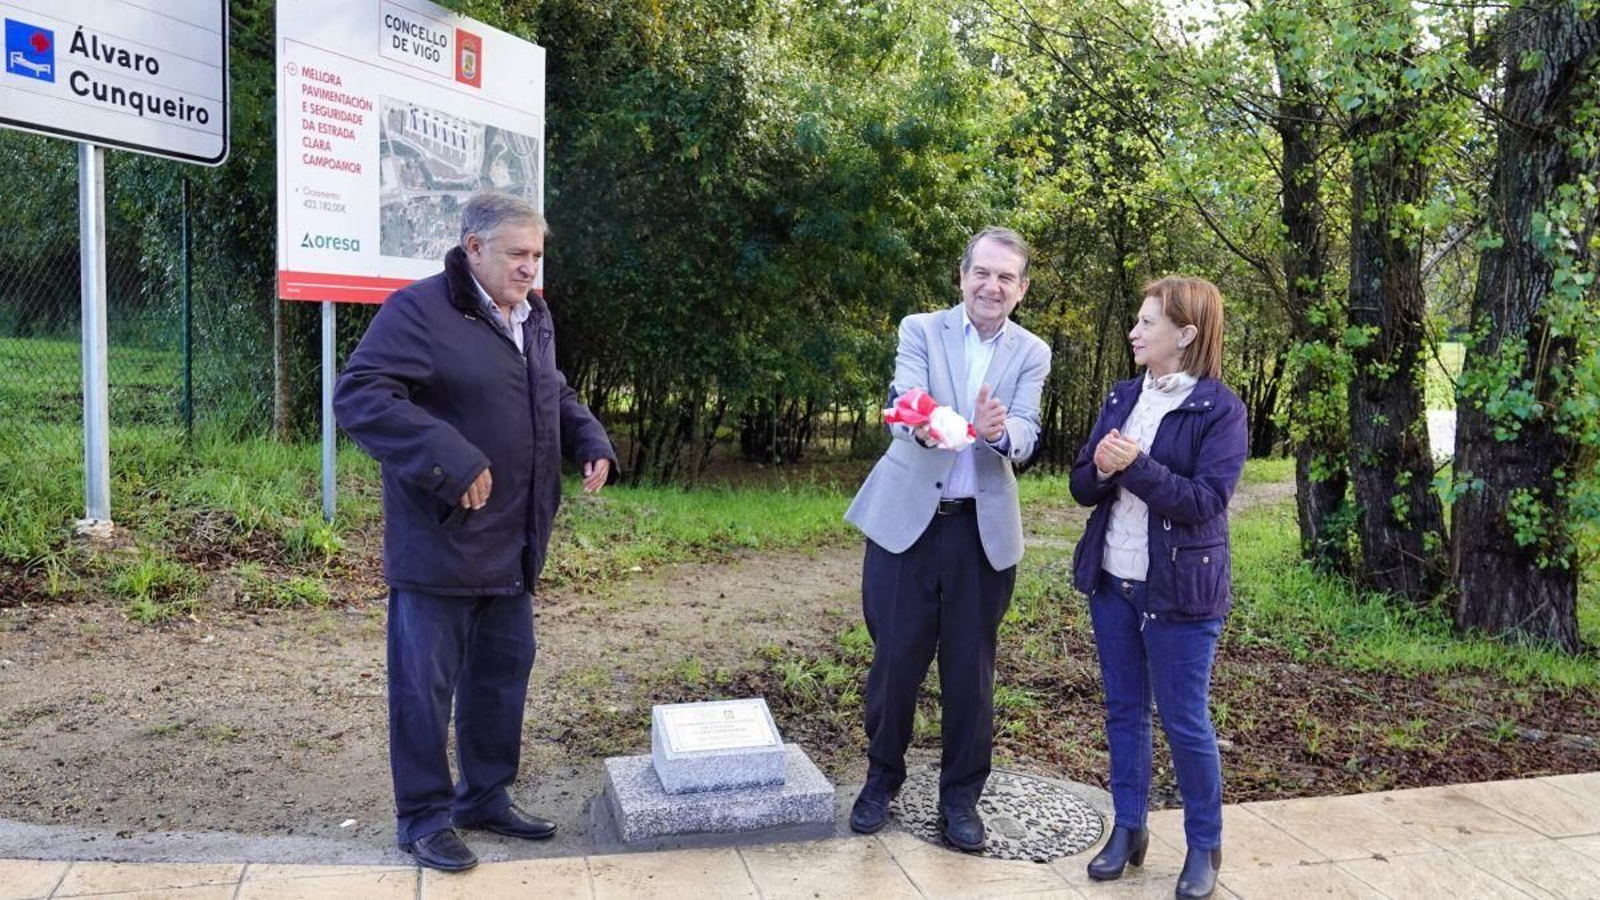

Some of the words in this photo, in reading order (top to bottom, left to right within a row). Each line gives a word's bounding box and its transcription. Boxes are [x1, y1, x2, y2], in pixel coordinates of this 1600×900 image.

[385, 14, 447, 48] CONCELLO
[70, 25, 160, 75] Álvaro
[393, 34, 408, 52] DE
[413, 42, 440, 62] VIGO
[302, 66, 342, 87] MELLORA
[70, 70, 209, 125] Cunqueiro
[302, 101, 307, 112] E
[310, 103, 363, 125] SEGURIDADE
[302, 119, 315, 131] DA
[318, 122, 355, 140] ESTRADA
[302, 136, 331, 152] CLARA
[302, 154, 362, 174] CAMPOAMOR
